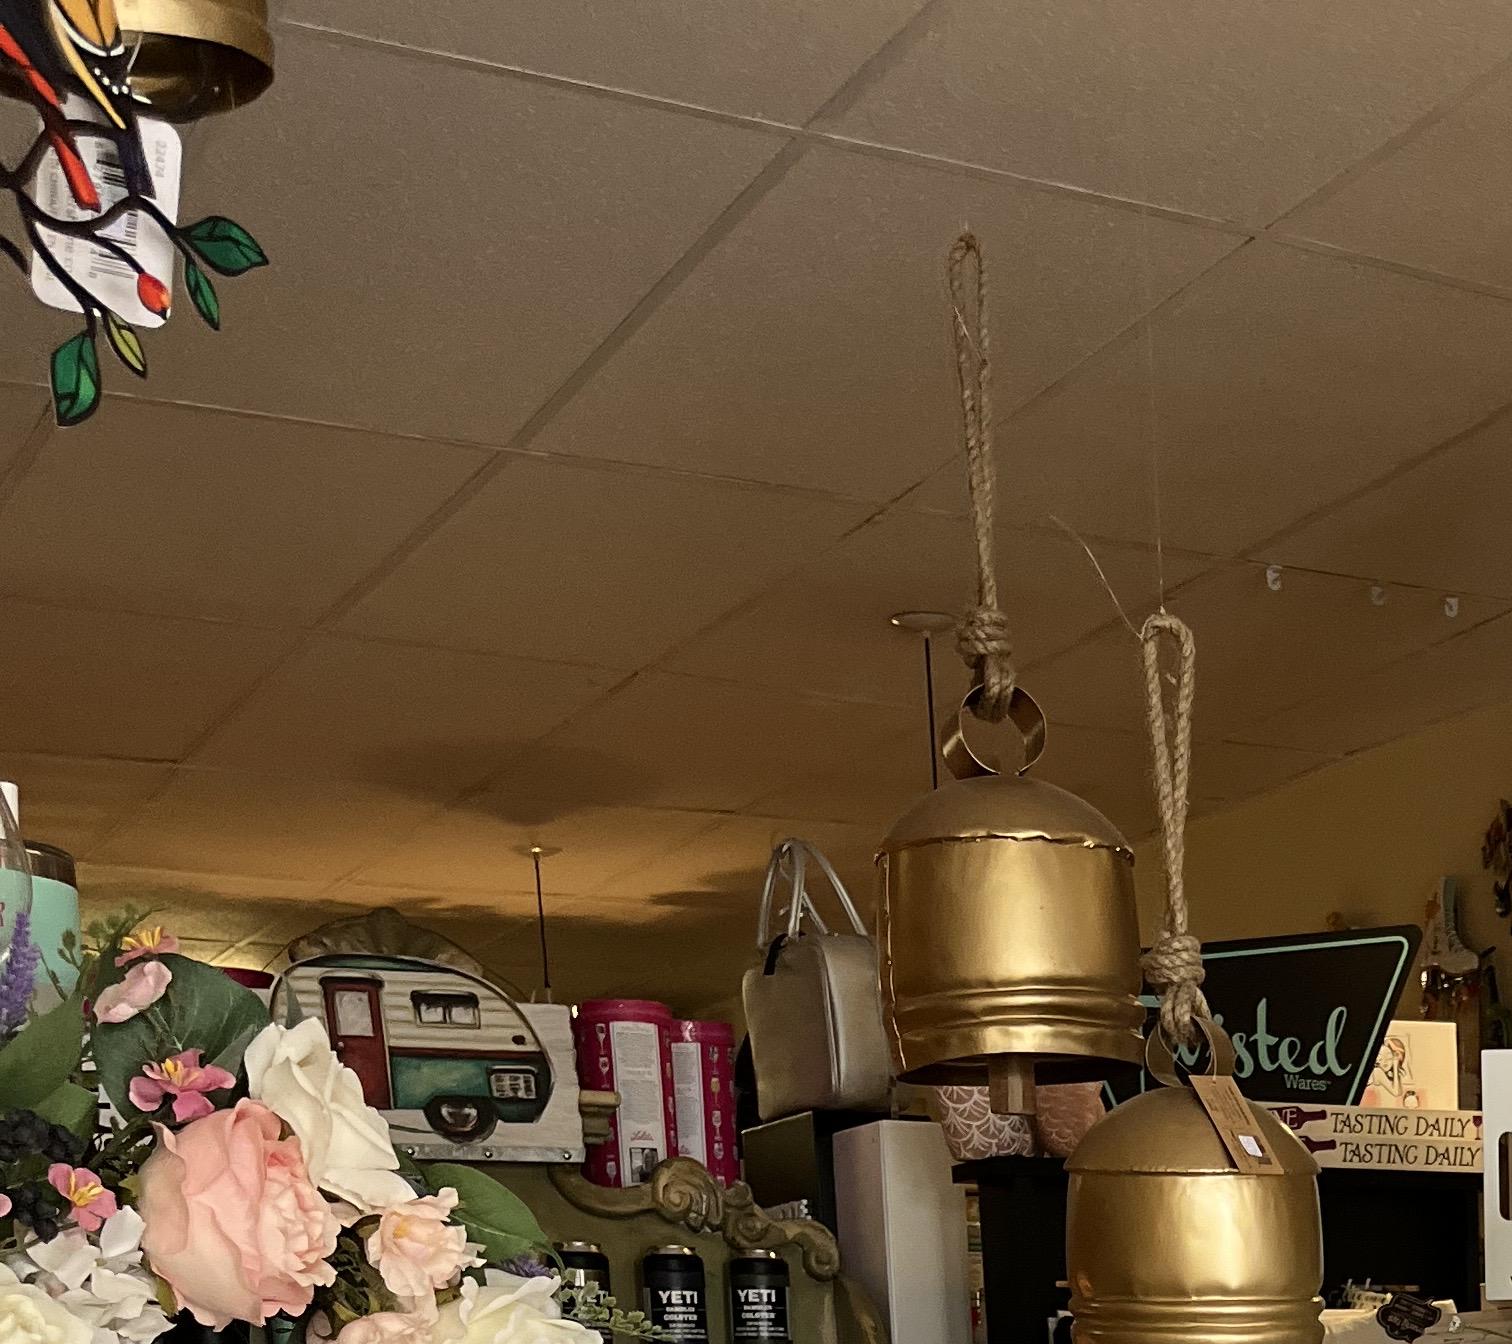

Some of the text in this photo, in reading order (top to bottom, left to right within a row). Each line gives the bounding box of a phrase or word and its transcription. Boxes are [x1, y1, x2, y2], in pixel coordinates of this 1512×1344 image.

[1330, 1112, 1472, 1139] TASTING DAILY
[1338, 1140, 1482, 1168] TASTING DAILY
[658, 1290, 698, 1304] YETI
[736, 1289, 777, 1303] YETI
